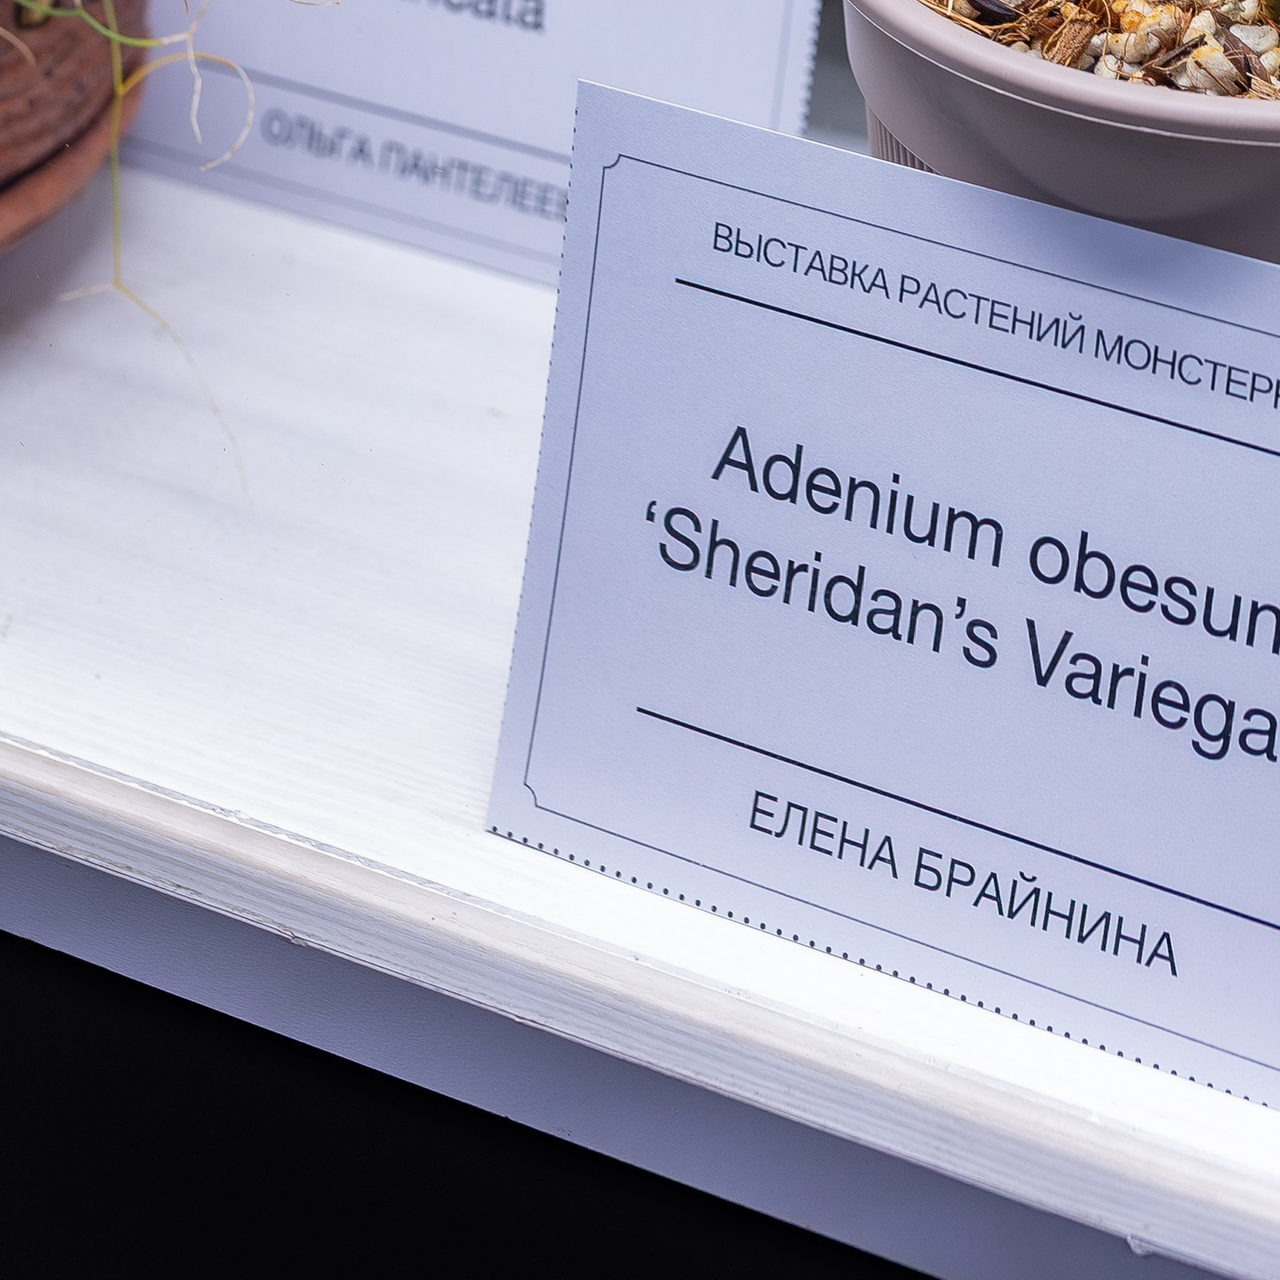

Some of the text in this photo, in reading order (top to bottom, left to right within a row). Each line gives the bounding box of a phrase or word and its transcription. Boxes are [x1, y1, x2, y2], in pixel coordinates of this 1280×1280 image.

[259, 107, 375, 169] ОЛЬГА
[712, 221, 891, 300] ВЫСТАВКА
[898, 273, 1086, 354] РАСТЕНИЙ
[710, 425, 1004, 568] Adenium
[645, 500, 998, 669] ‘Sheridan’s
[749, 790, 1178, 977] ЕЛЕНА БРАЙНИНА
